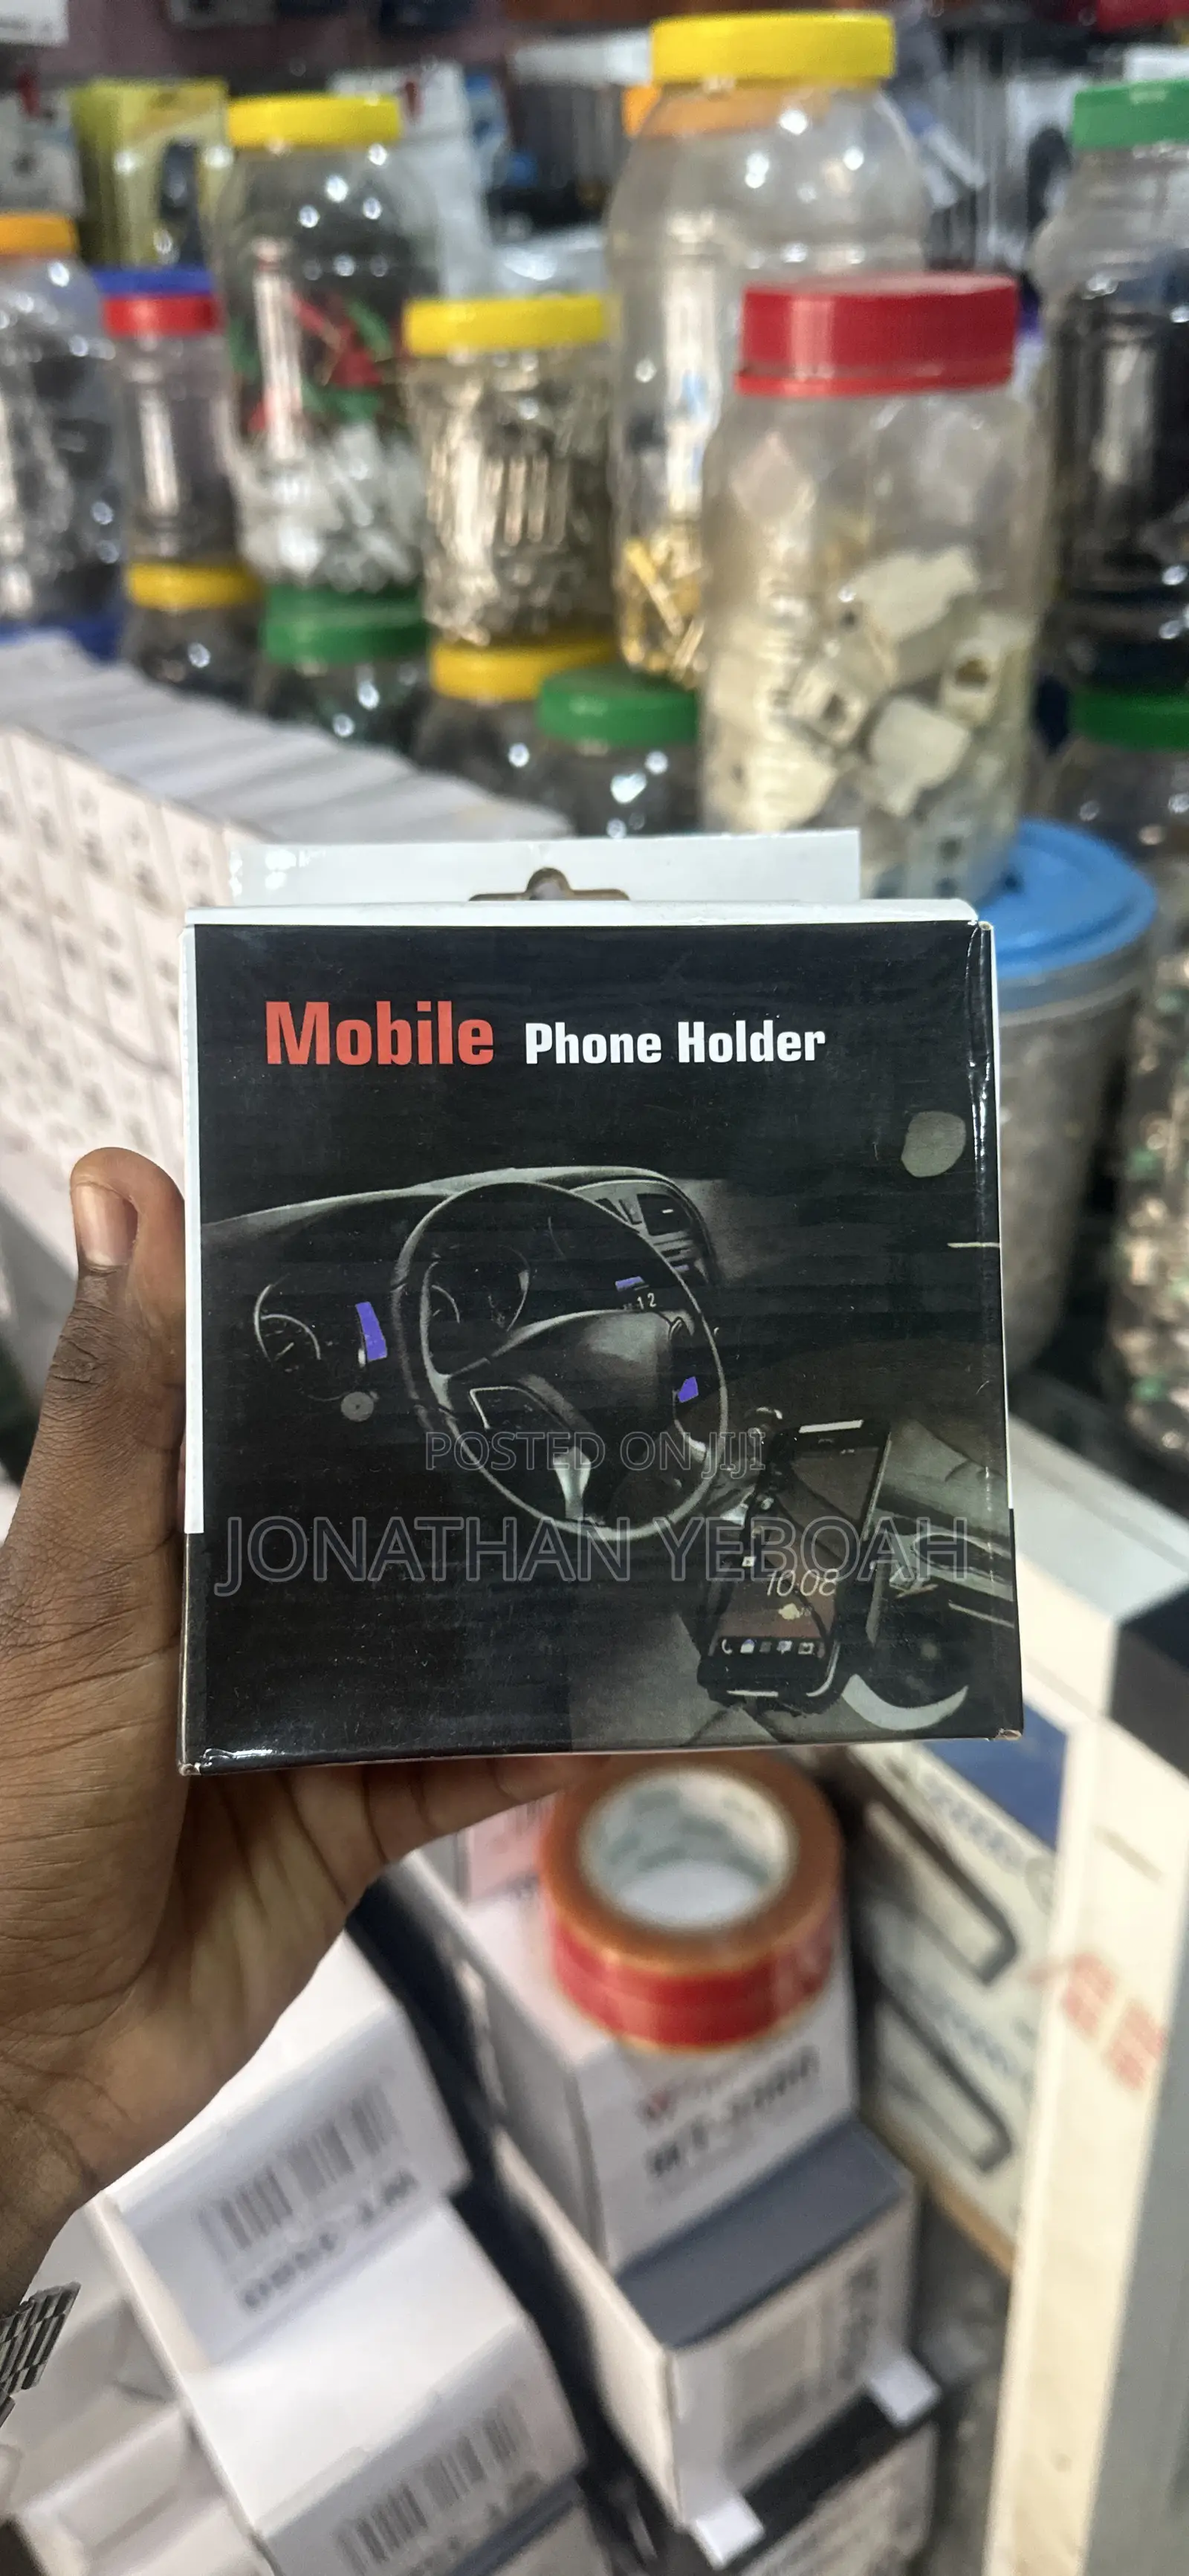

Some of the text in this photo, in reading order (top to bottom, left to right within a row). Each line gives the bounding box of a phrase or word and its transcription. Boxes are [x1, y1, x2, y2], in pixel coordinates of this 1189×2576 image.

[265, 1000, 826, 1065] Mobile Phone Holder
